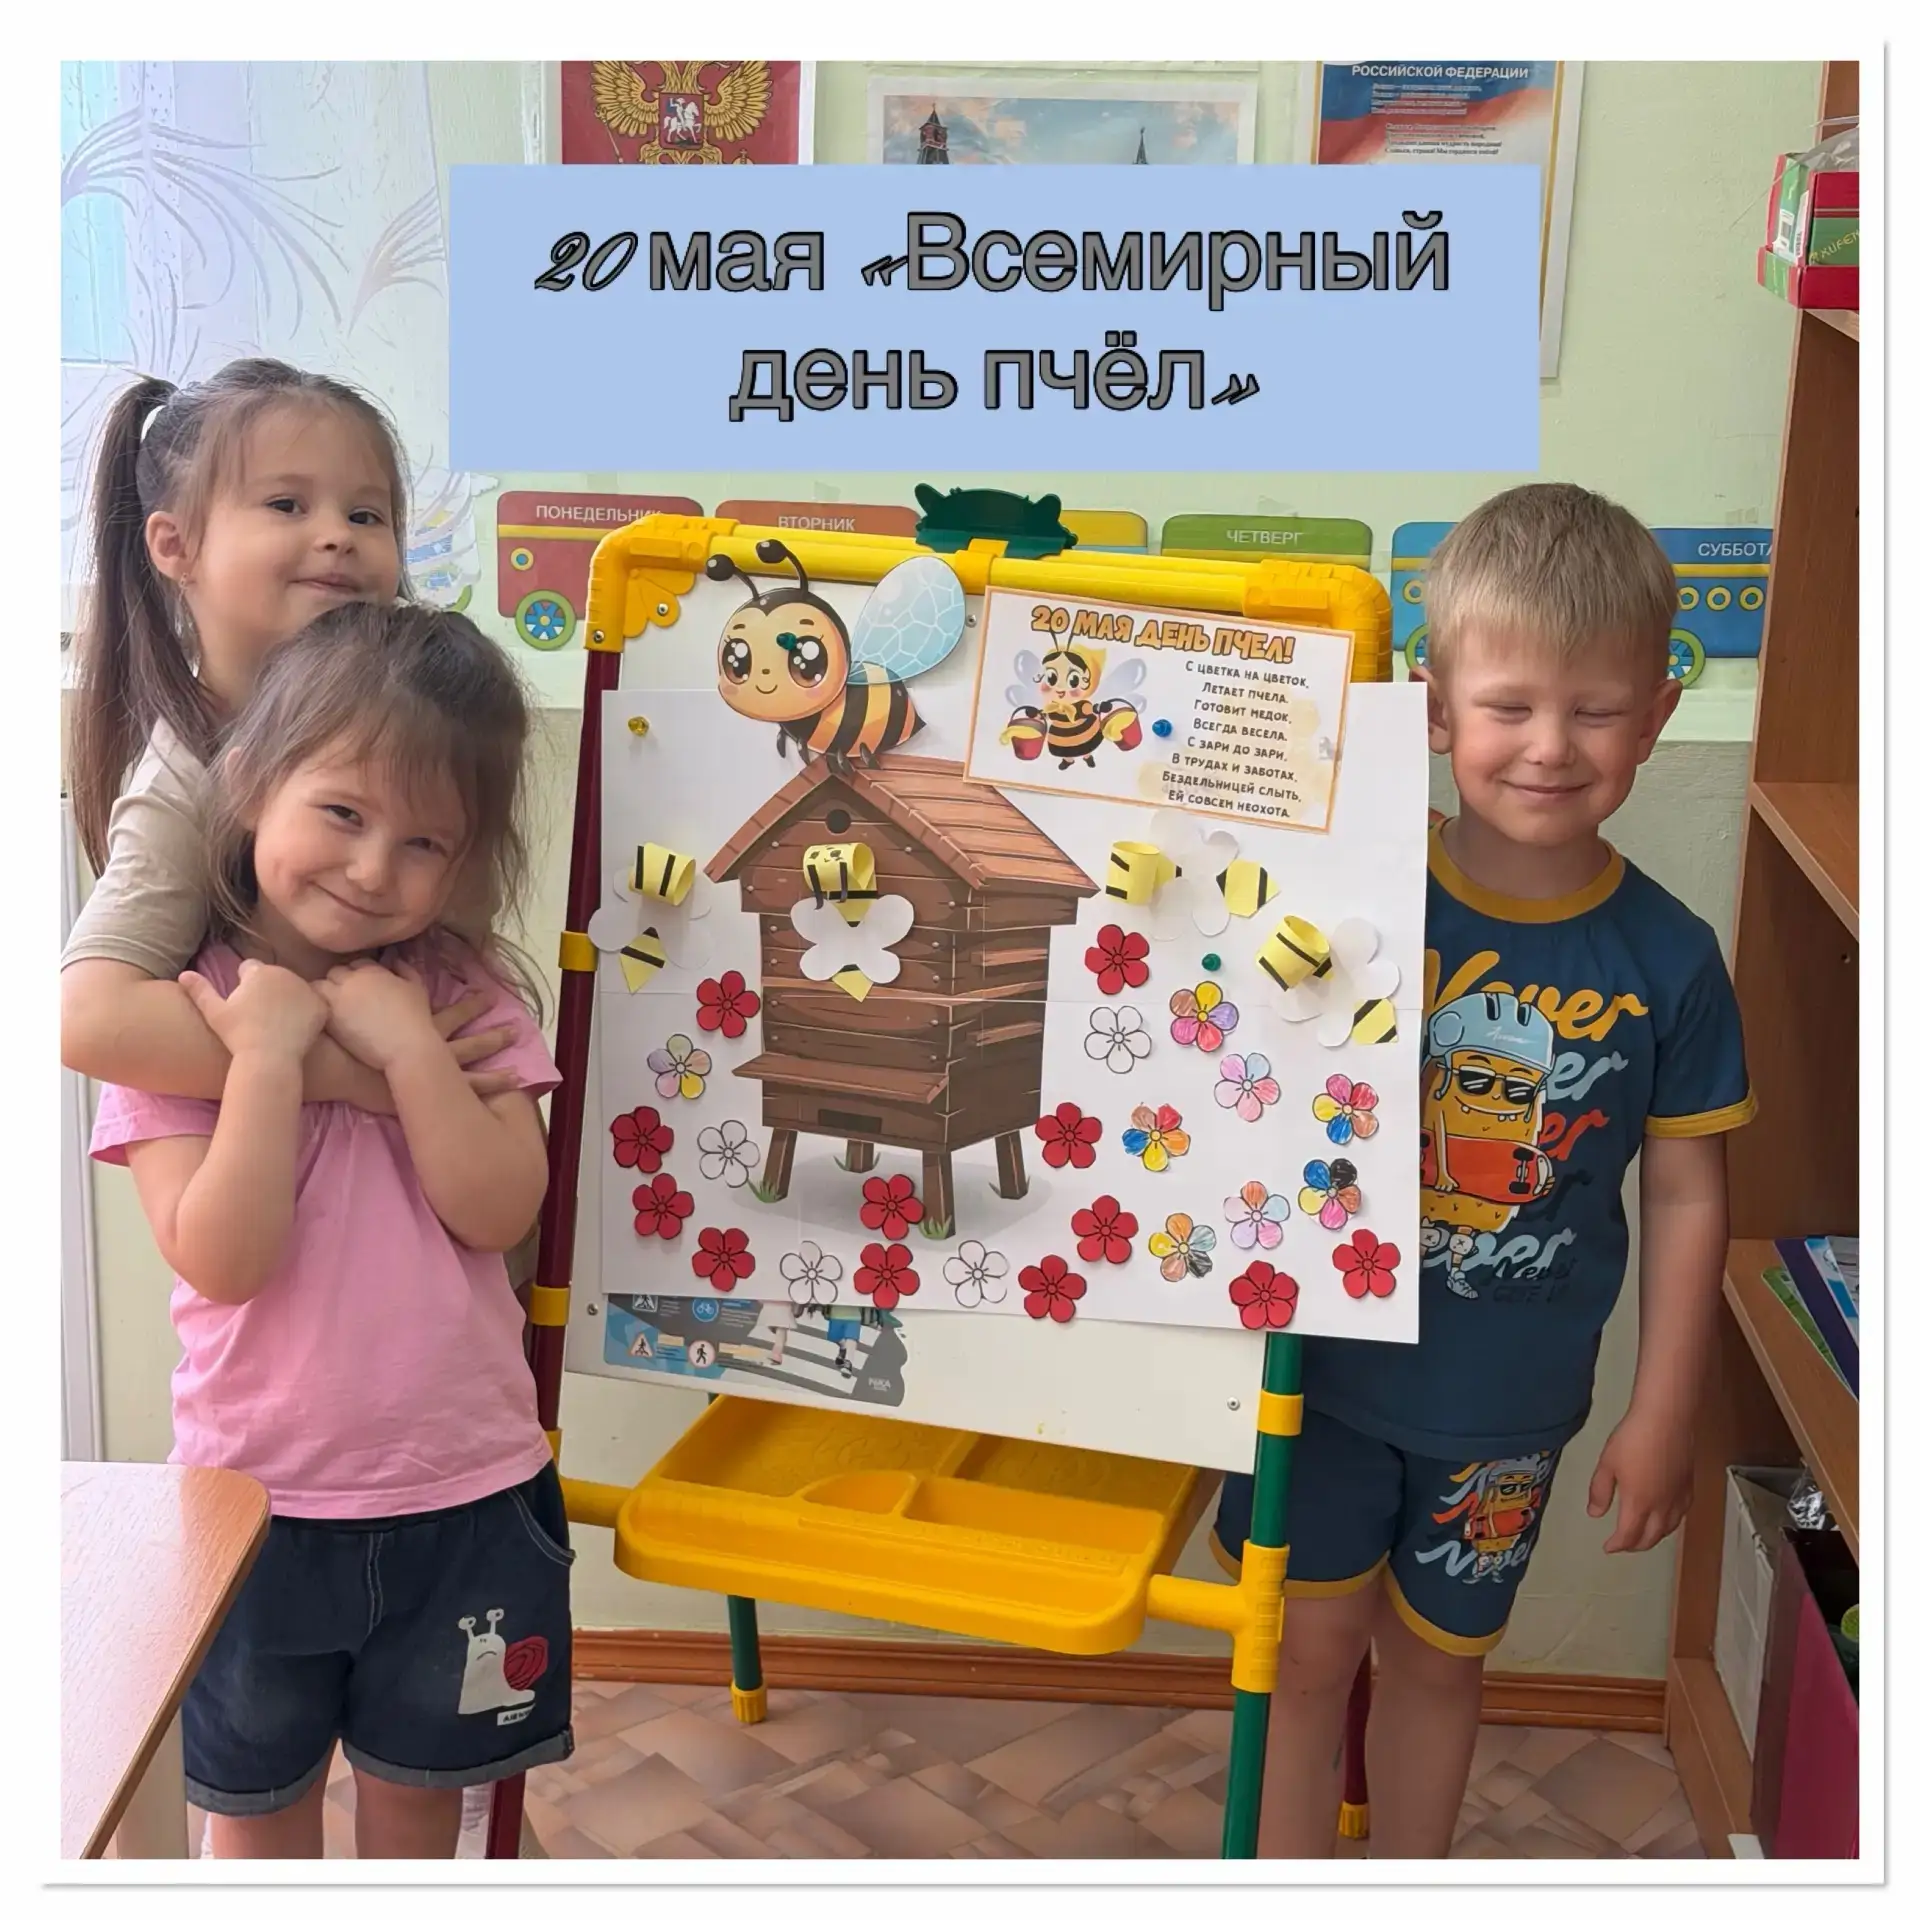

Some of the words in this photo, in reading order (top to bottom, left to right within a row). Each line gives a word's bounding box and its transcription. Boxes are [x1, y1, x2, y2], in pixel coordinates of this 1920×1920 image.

[1351, 64, 1443, 78] РОССИЙСКОЙ
[1445, 65, 1529, 79] ФЕДЕРАЦИИ
[778, 516, 856, 532] ВТОРНИК
[1227, 530, 1304, 545] ЧЕТВЕРГ
[1031, 605, 1070, 634] 20
[1072, 609, 1135, 643] МАЯ
[1133, 619, 1211, 653] ДЕНЬ
[1212, 629, 1296, 664] ПЧЕЛ!
